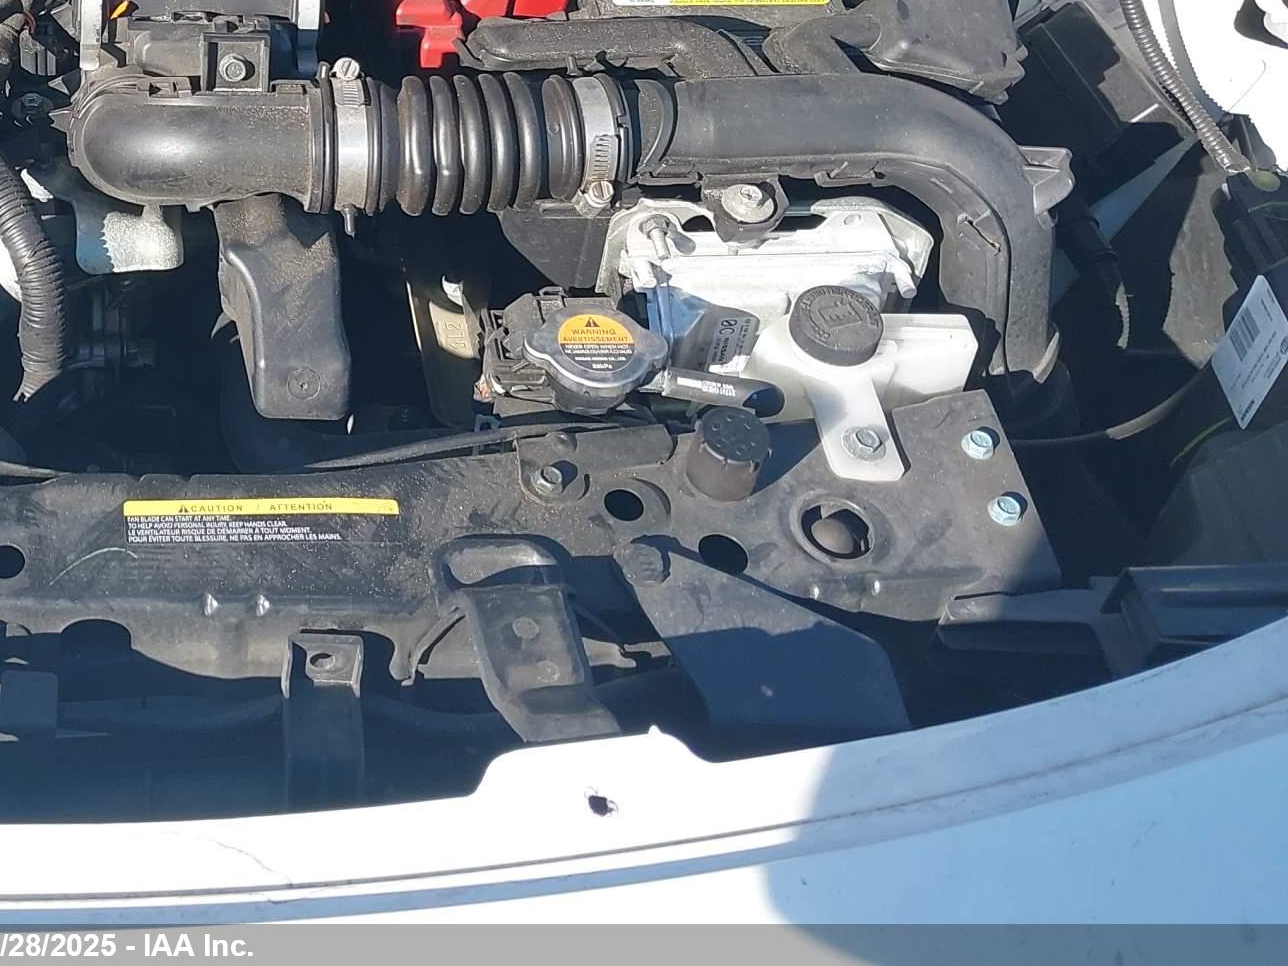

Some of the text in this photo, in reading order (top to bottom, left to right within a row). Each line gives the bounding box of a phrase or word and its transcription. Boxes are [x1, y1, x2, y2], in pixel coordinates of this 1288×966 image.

[190, 504, 243, 512] CAUTION
[269, 503, 333, 511] ATTENTION
[136, 528, 181, 536] VENTILATEUR
[128, 535, 148, 543] POUR
[229, 534, 239, 542] NE
[264, 533, 305, 541] APPROCHER
